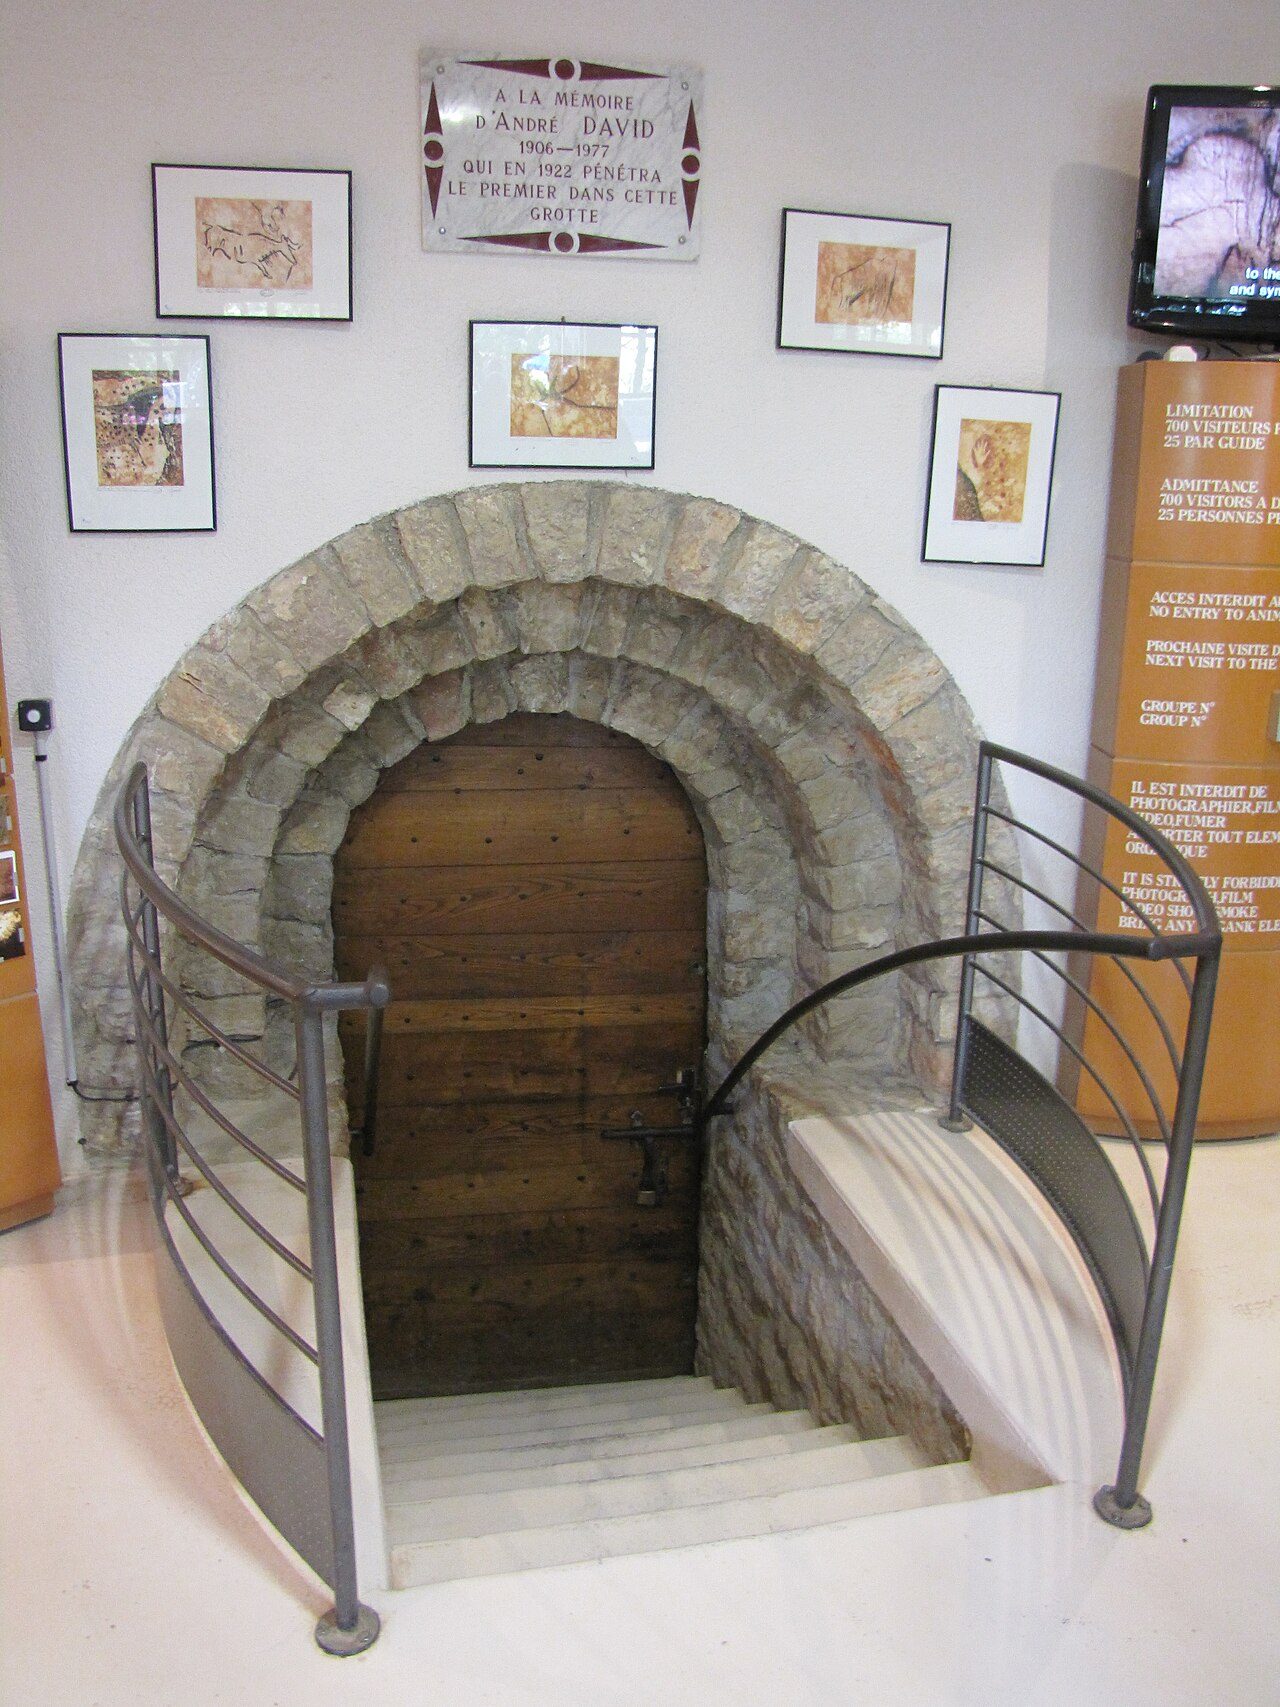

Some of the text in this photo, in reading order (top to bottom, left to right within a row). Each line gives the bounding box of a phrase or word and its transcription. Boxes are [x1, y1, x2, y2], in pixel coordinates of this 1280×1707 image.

[495, 89, 634, 111] A LA MÉMOIRE
[583, 116, 655, 139] DAVID
[463, 160, 662, 183] QUI EN 1922 PÉNÉTRA
[448, 181, 678, 206] LE PREMIER DANS CETTE
[530, 207, 599, 223] GROTTE
[1246, 267, 1280, 280] to the
[1229, 283, 1255, 296] and
[1165, 404, 1254, 419] LIMITATION
[1165, 420, 1189, 433] 700
[1193, 421, 1271, 435] VISITEURS
[1164, 435, 1266, 450] 25 PAR GUIDE
[1160, 478, 1259, 493] ADMITTANCE
[1159, 493, 1183, 506] 700
[1187, 494, 1253, 508] VISITORS
[1255, 496, 1267, 509] A
[1157, 509, 1175, 521] 25
[1177, 509, 1264, 524] PERSONNES
[1151, 591, 1194, 605] ACCES
[1198, 592, 1267, 607] INTERDIT
[1149, 605, 1170, 618] NO
[1173, 606, 1222, 620] ENTRY
[1224, 608, 1245, 621] TO
[1146, 639, 1225, 655] PROCHAINE
[1228, 642, 1269, 656] VISITE
[1145, 653, 1278, 670] NEXT VISIT TO THE
[1140, 699, 1197, 714] GROUPE
[1139, 714, 1188, 727] GROUP
[1130, 780, 1268, 799] IL EST INTERDIT DE
[1206, 830, 1245, 844] TOUT
[1122, 871, 1138, 884] IT
[1140, 873, 1154, 886] IS
[1164, 919, 1197, 932] ANY
